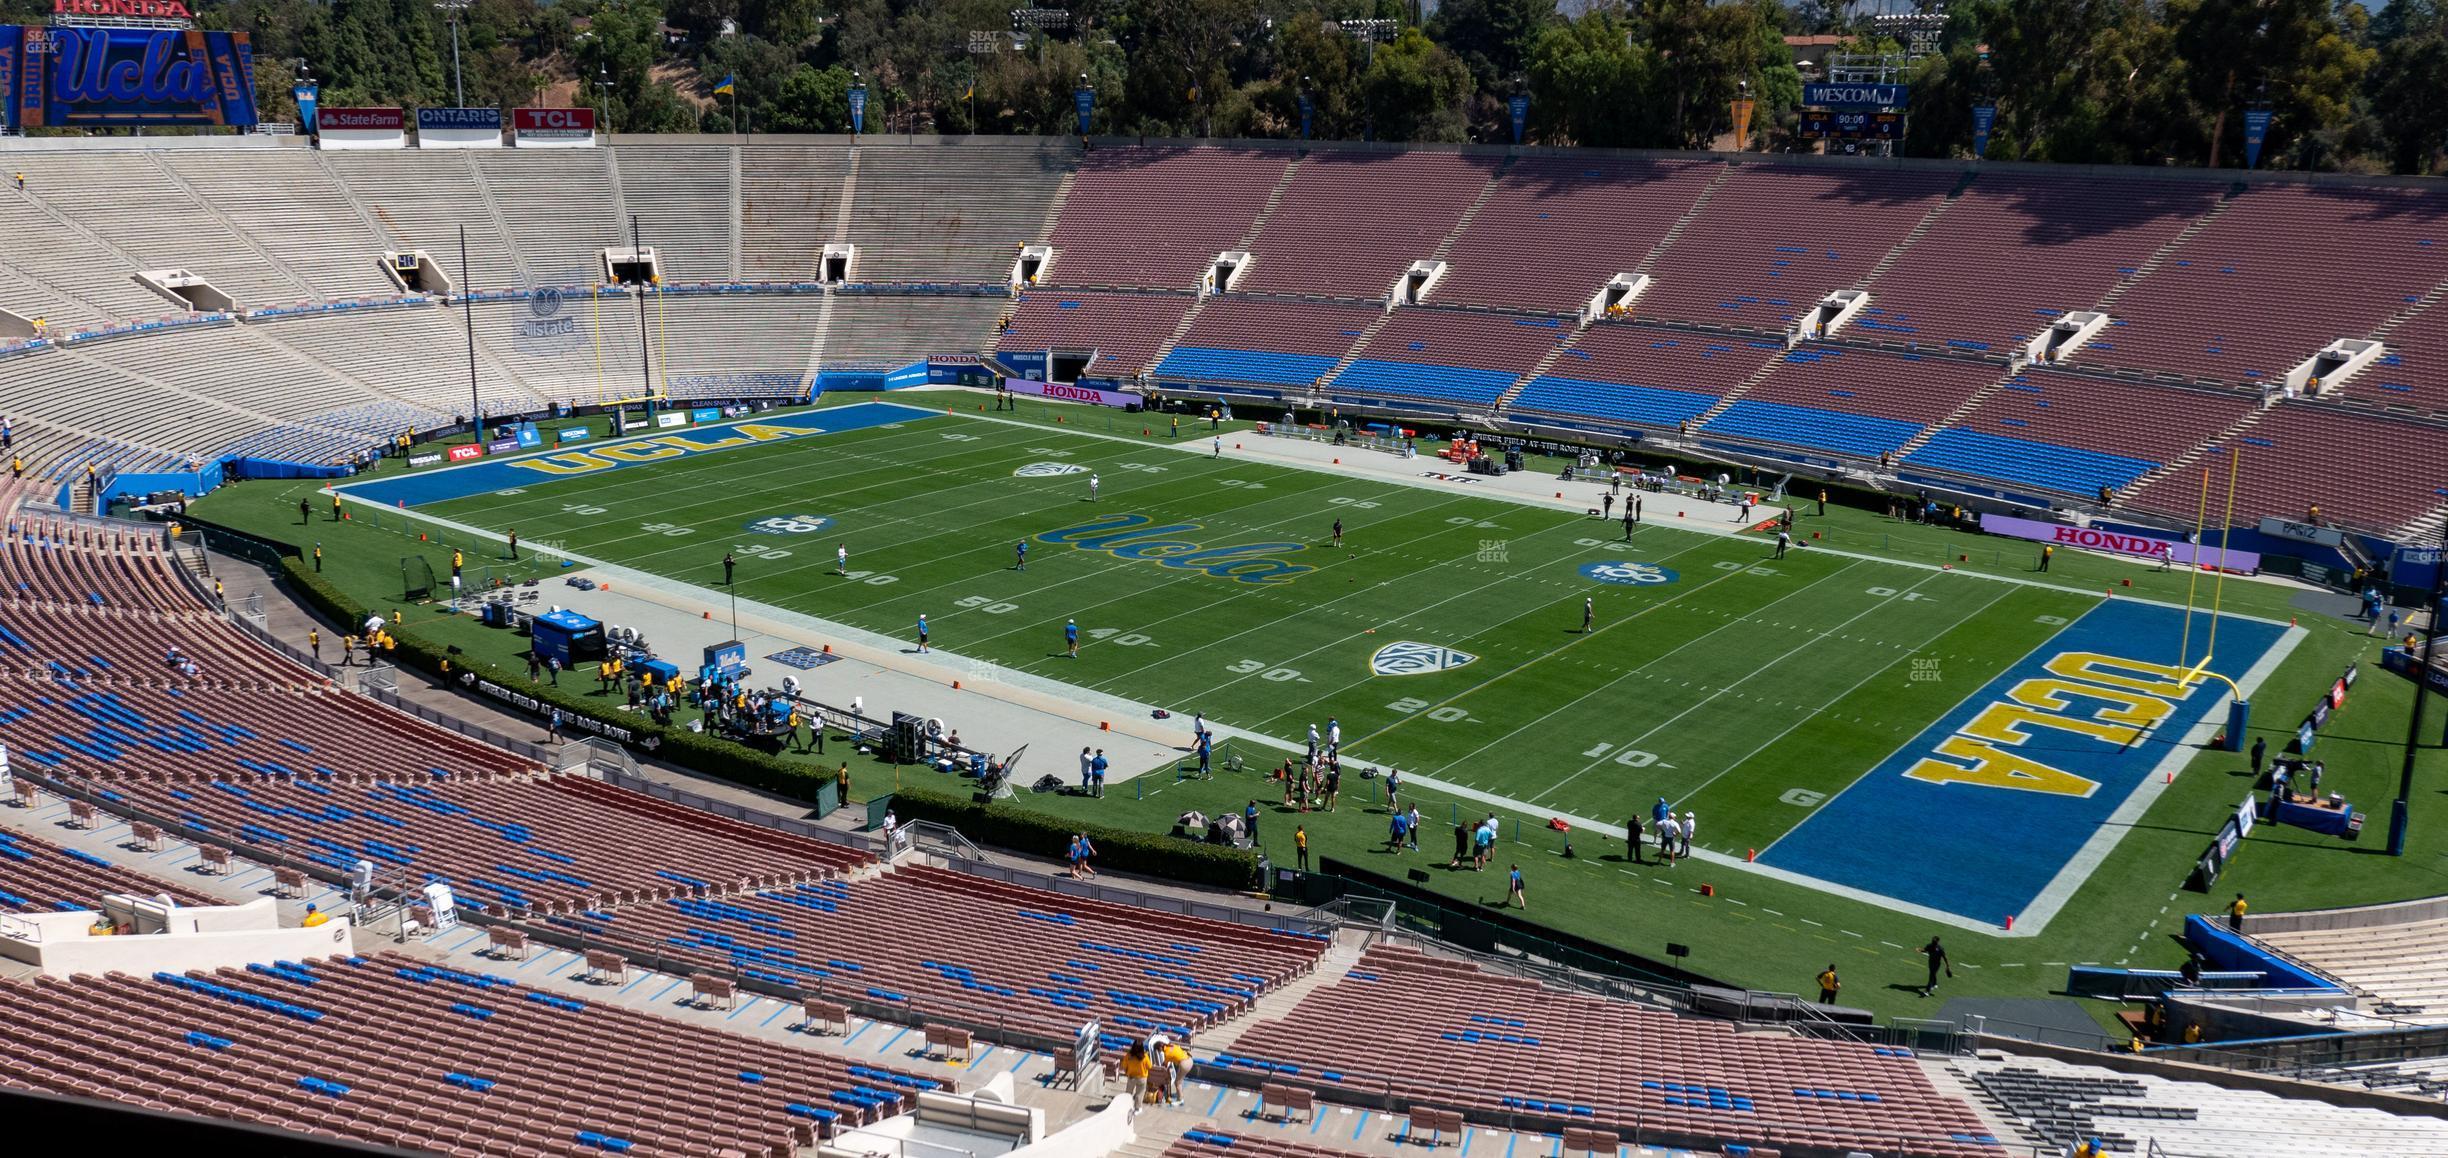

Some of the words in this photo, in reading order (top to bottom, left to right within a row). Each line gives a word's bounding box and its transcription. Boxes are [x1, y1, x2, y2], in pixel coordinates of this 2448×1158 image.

[56, 0, 192, 18] HONDA
[54, 30, 215, 102] Ucla
[216, 54, 240, 101] UCLA
[1813, 88, 1877, 103] WESCOM
[340, 114, 371, 126] State
[372, 115, 399, 126] Farm
[421, 110, 499, 122] ONTARIO
[529, 111, 581, 127] TCL
[1839, 115, 1864, 124] 90:00
[1814, 122, 1819, 130] 0
[1883, 124, 1889, 132] 0
[399, 255, 416, 267] 40
[521, 318, 574, 337] Allstate
[929, 355, 979, 364] HONDA
[1043, 384, 1104, 402] HONDA
[453, 447, 478, 458] TCL
[504, 423, 827, 475] UCLA
[1504, 436, 1526, 446] FIELD
[1559, 444, 1579, 453] ROSE
[409, 454, 442, 465] NISSAN
[1032, 513, 1319, 584] Ucla
[2054, 526, 2175, 559] HONDA
[1591, 565, 1667, 582] 100
[479, 680, 512, 702] SPIEKER
[512, 692, 538, 710] FIELD
[540, 703, 551, 716] AT
[577, 715, 602, 733] ROSE
[603, 724, 634, 743] BOWL
[1901, 651, 2209, 798] UCLA
[1777, 787, 1828, 808] G
